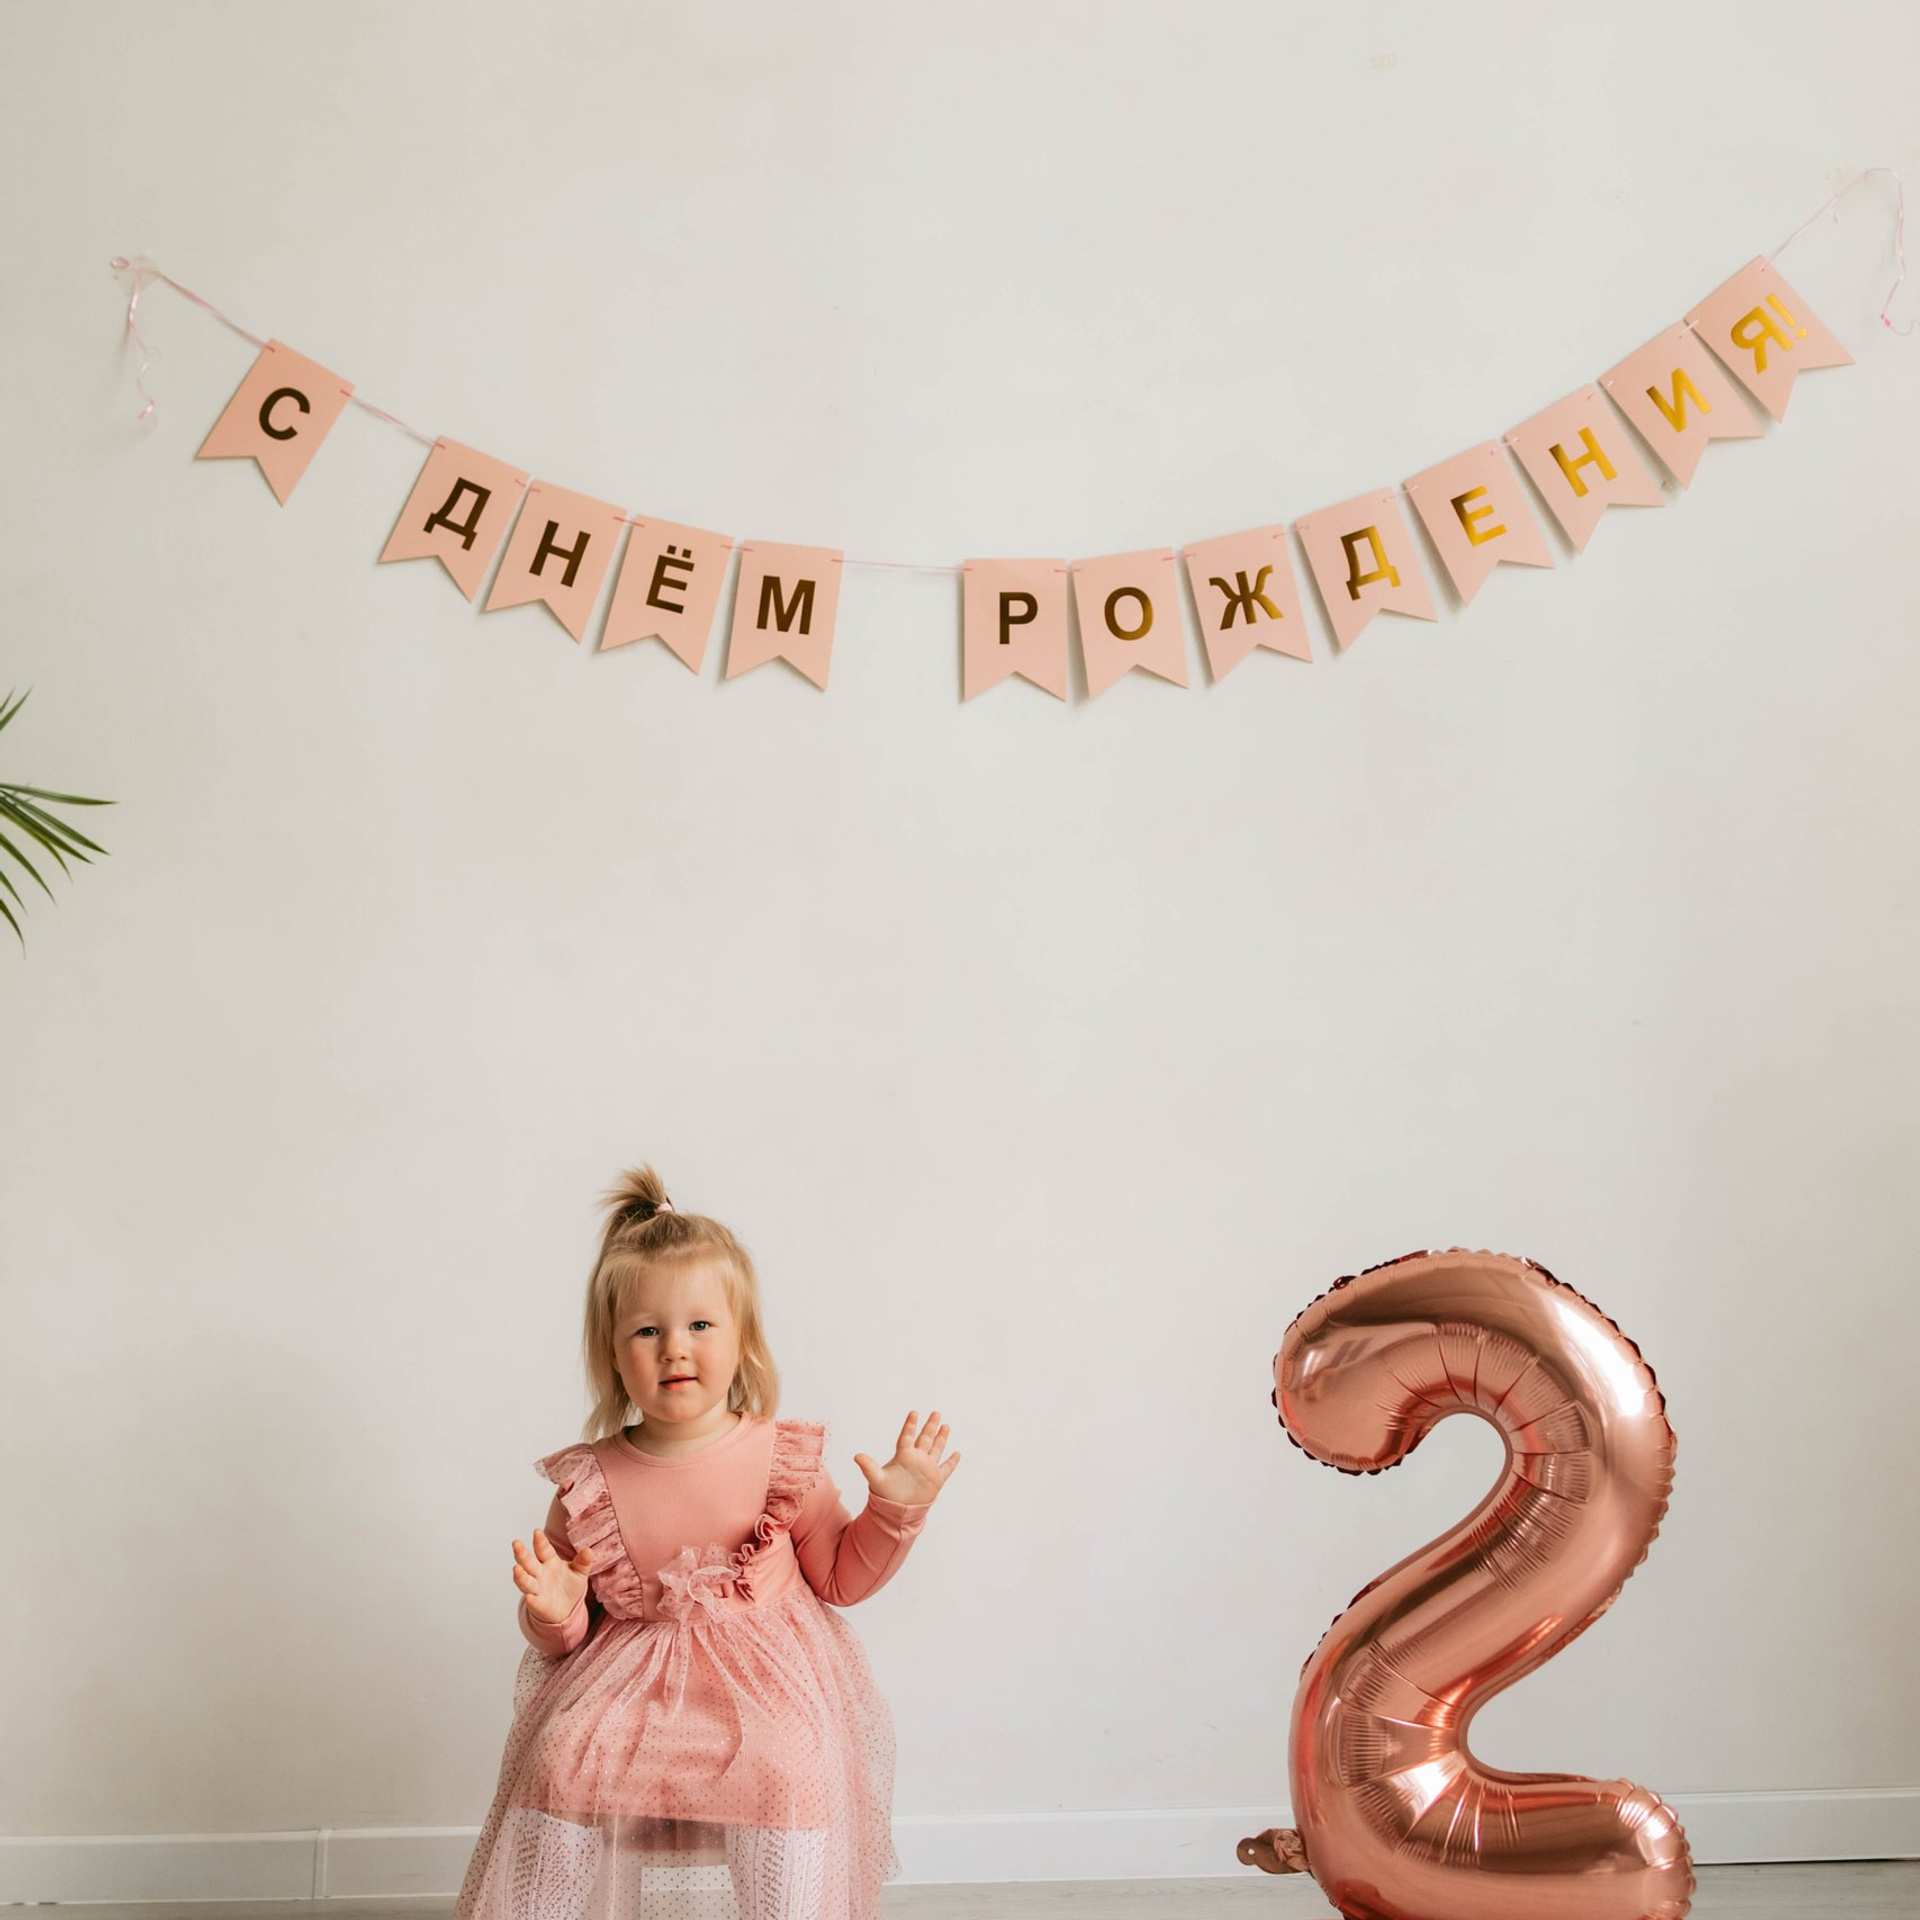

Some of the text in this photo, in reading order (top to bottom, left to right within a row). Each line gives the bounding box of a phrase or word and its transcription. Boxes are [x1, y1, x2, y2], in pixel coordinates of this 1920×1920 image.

[258, 293, 1808, 646] С ДНЁМ РОЖДЕНИЯ!
[1272, 1246, 1697, 1920] 2
